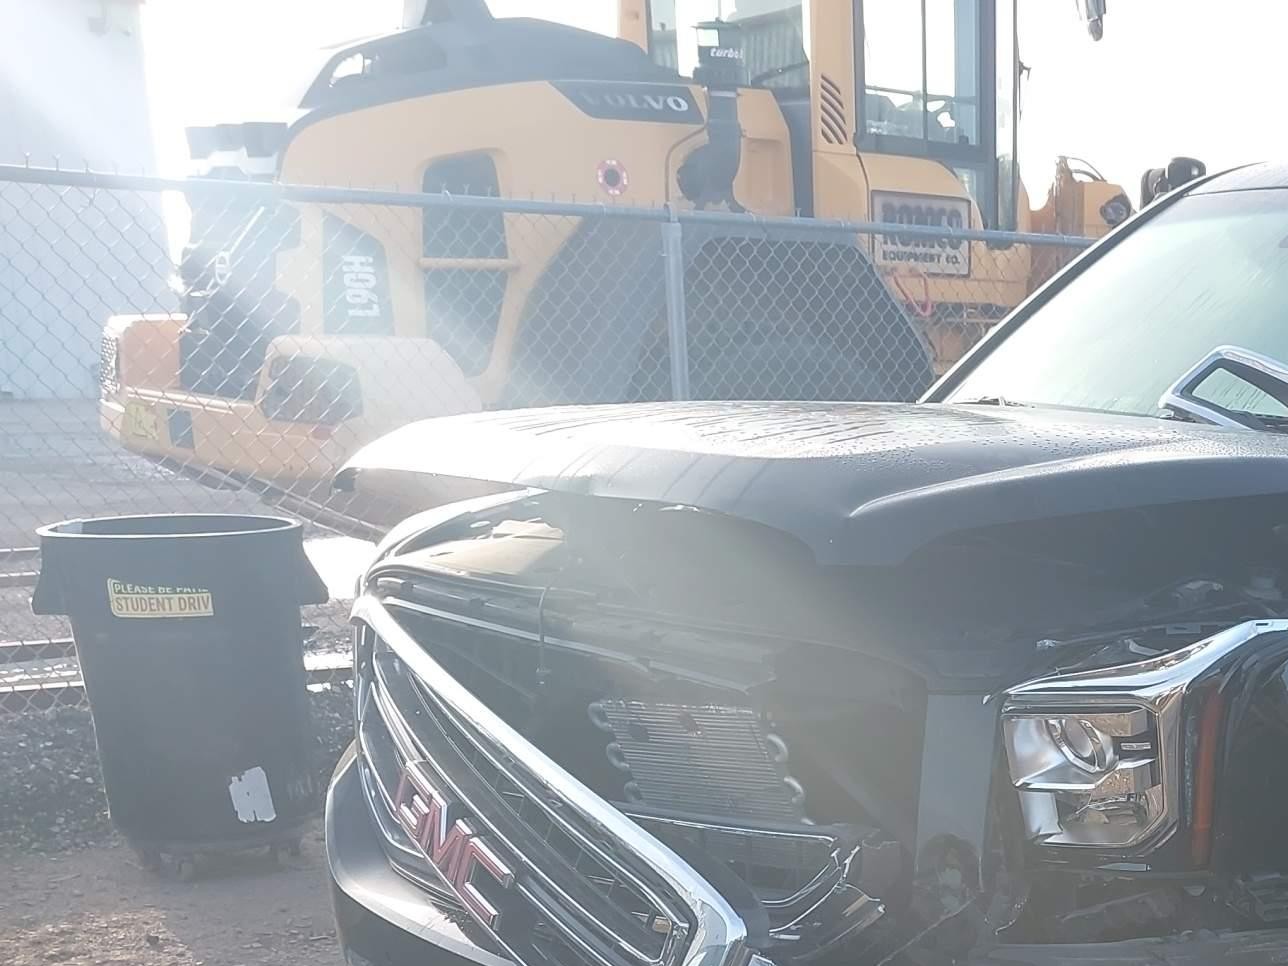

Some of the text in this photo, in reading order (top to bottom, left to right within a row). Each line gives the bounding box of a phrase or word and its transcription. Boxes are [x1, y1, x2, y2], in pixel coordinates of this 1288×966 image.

[577, 89, 689, 111] VOLVO
[882, 250, 942, 263] EQUIPMENT
[114, 583, 156, 593] PLEASE
[115, 595, 210, 611] STUDENT DRIV
[394, 761, 515, 930] GMC
